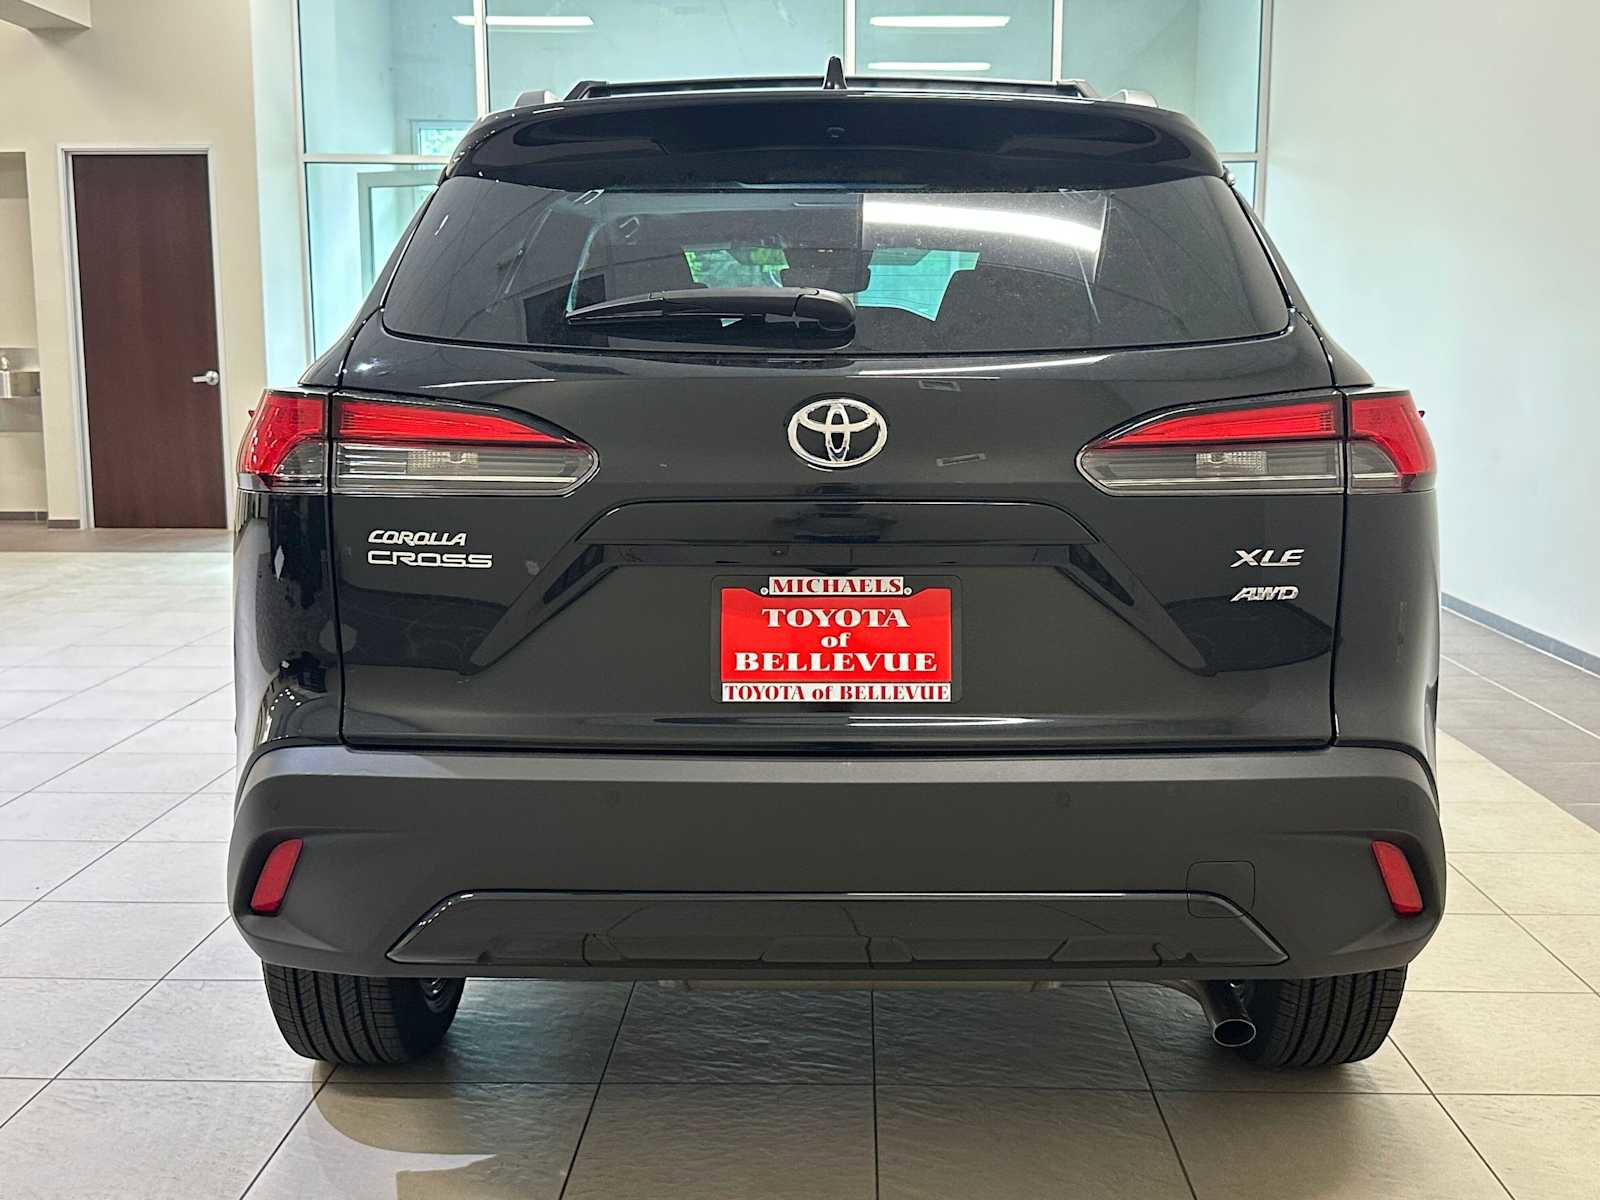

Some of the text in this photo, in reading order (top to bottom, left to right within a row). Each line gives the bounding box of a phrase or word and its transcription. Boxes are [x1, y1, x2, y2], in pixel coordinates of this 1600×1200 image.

[368, 529, 467, 546] COROLLA
[367, 550, 493, 569] CROSS
[1230, 549, 1305, 568] XLE
[772, 578, 902, 594] MICHAELS
[1230, 586, 1299, 602] AWD
[761, 608, 911, 628] TOYOTA
[820, 632, 852, 649] of
[734, 652, 938, 672] BELLEVUE
[724, 685, 950, 701] TOYOTA of BELLEVUE
